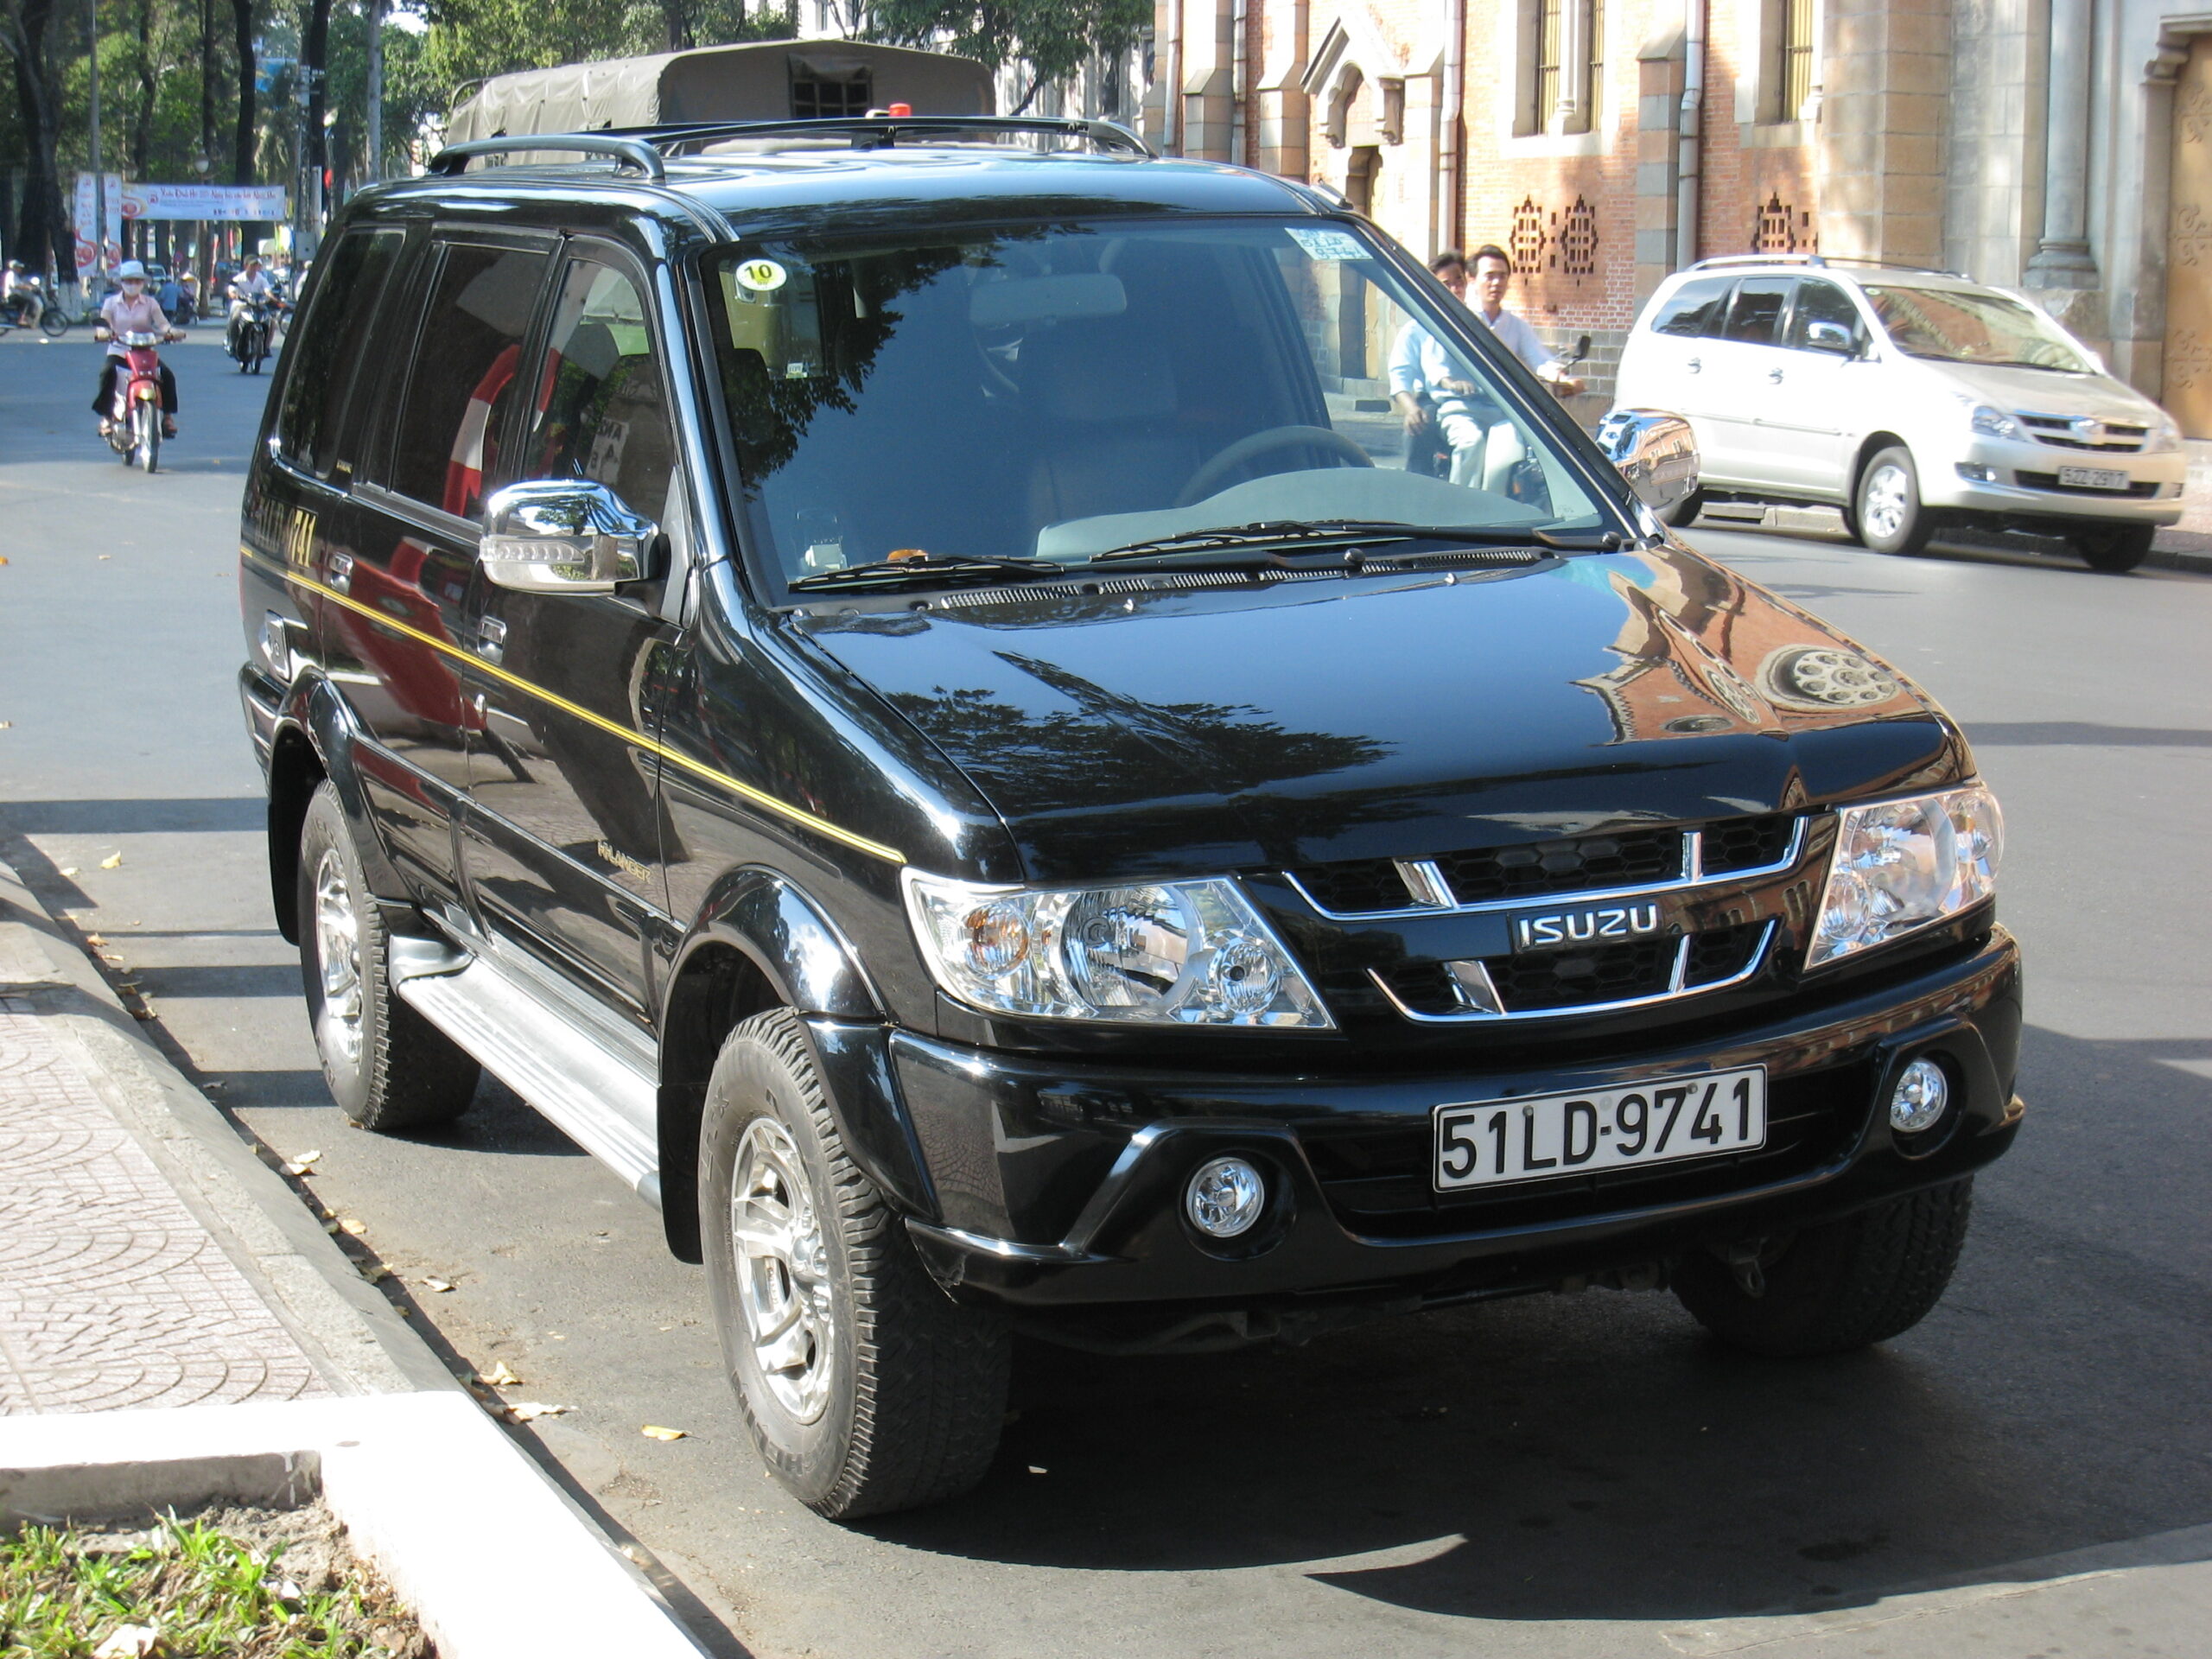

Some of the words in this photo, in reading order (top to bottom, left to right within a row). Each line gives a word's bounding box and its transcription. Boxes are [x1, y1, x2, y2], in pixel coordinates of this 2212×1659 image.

[744, 264, 772, 280] 10
[1518, 903, 1657, 947] ISUZU
[1441, 1077, 1751, 1179] 51LD-9741
